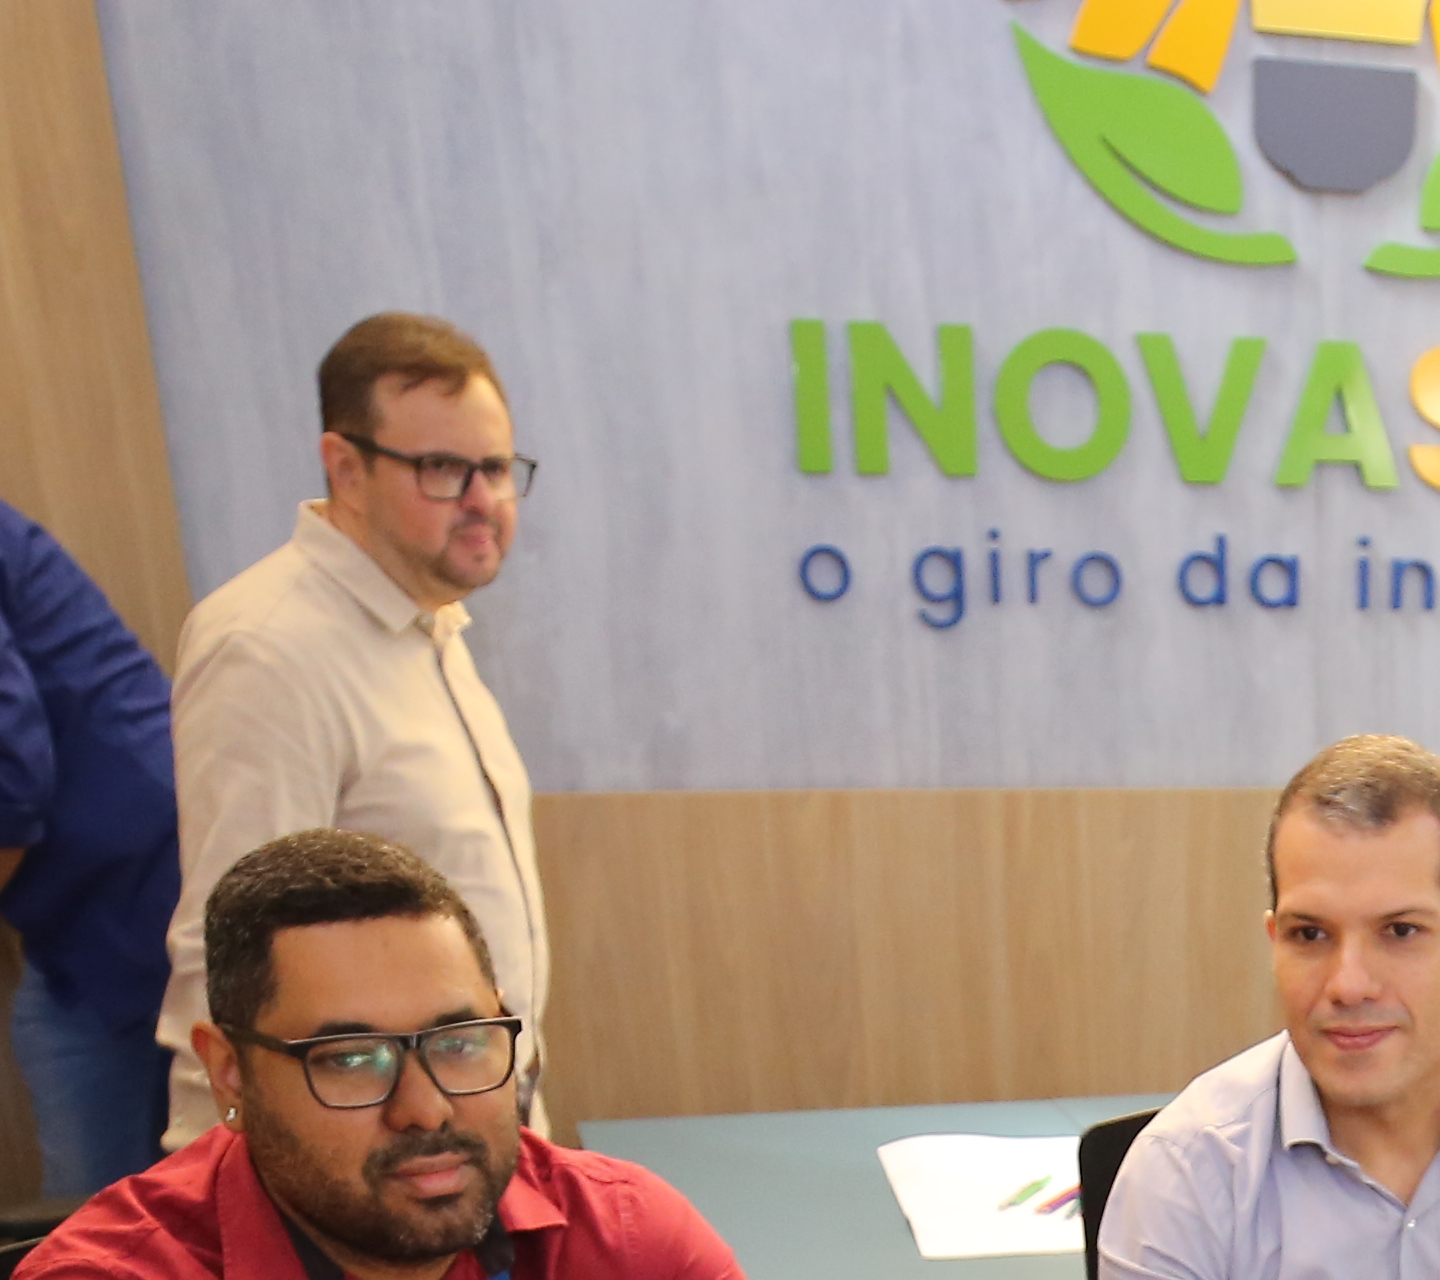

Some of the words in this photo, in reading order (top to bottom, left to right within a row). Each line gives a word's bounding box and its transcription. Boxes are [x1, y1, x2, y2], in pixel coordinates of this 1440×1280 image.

[799, 543, 853, 606] o
[912, 529, 1123, 630] giro
[1177, 535, 1302, 612] da
